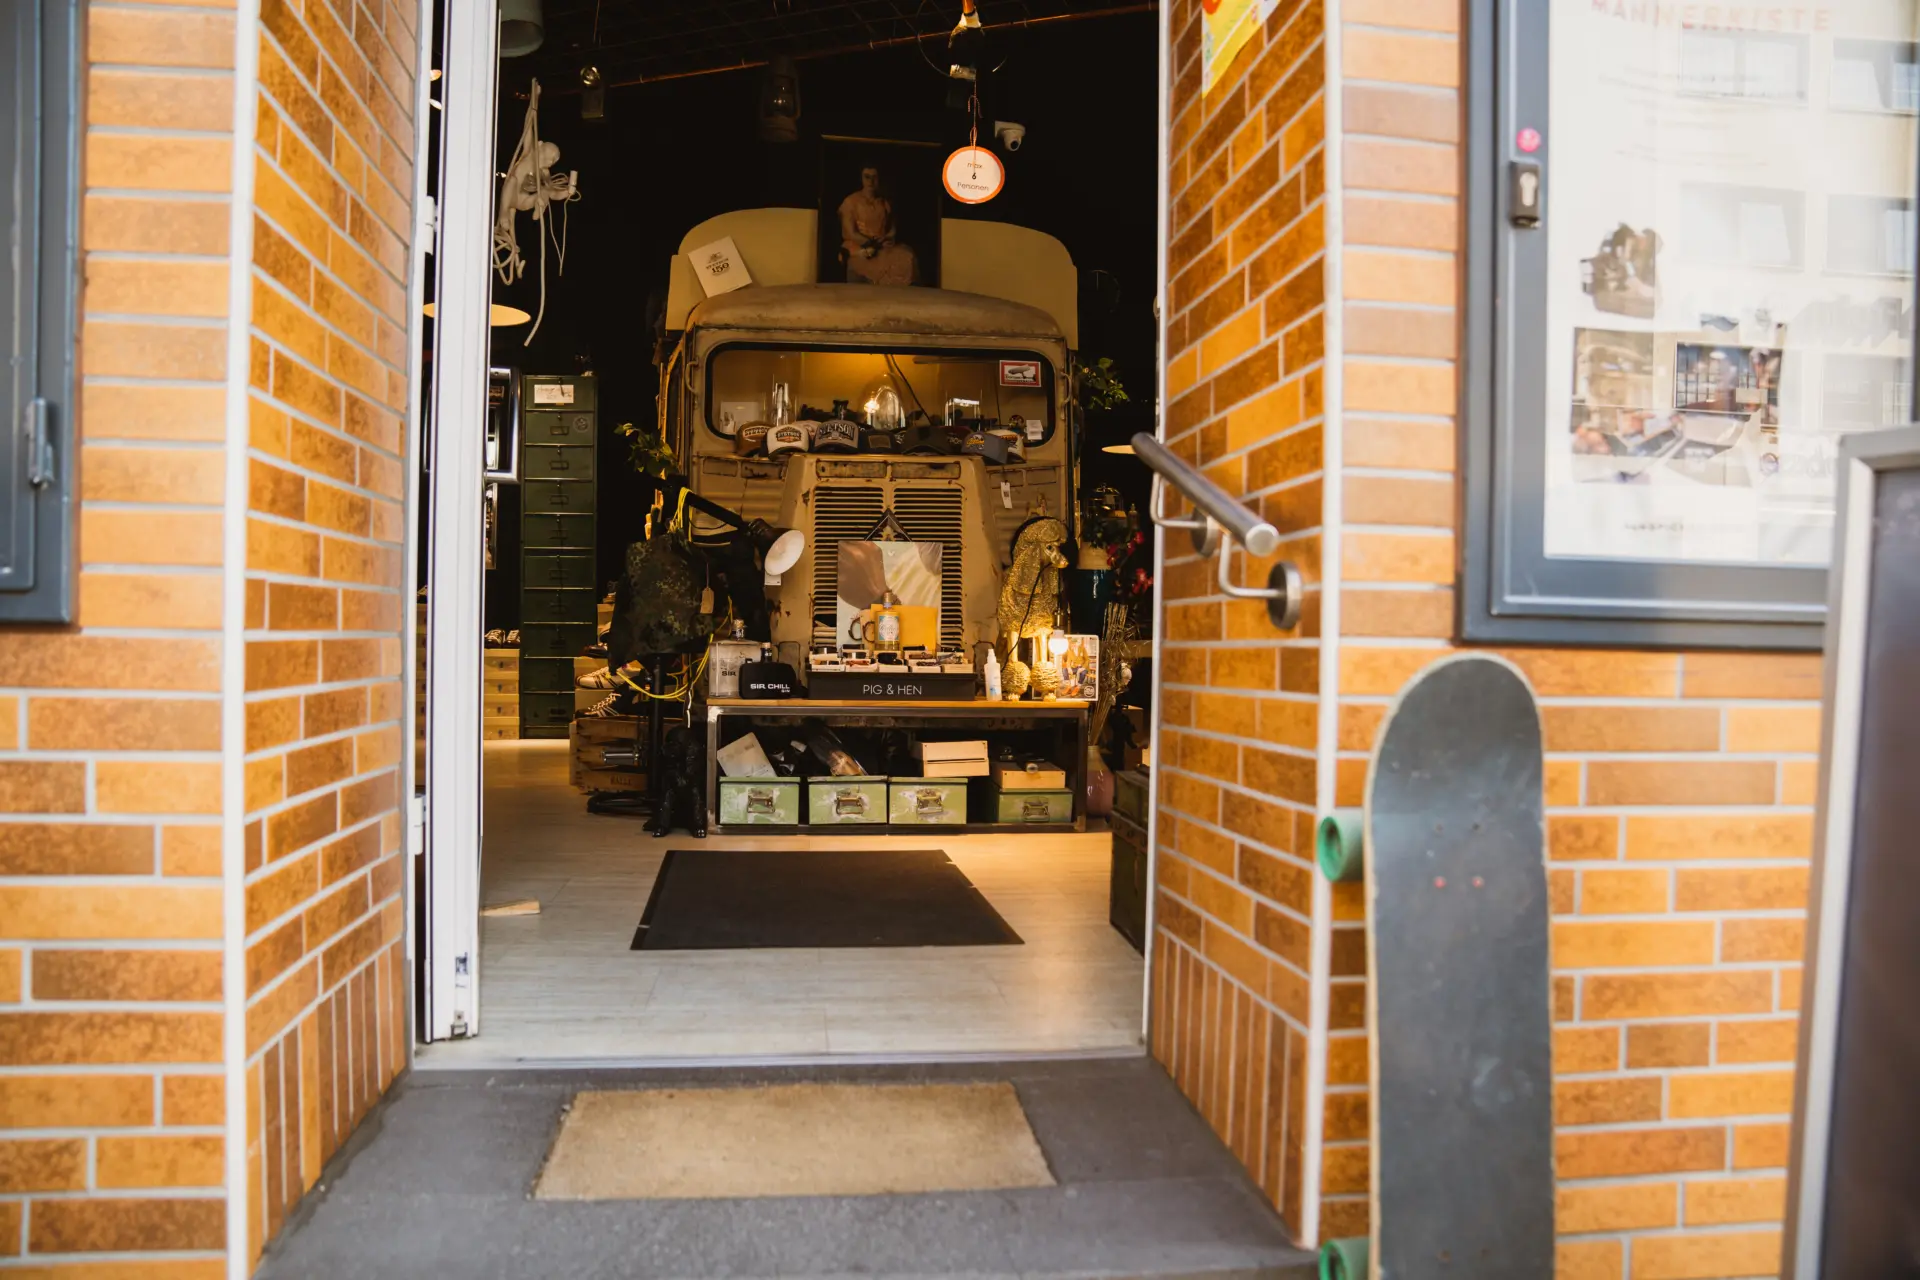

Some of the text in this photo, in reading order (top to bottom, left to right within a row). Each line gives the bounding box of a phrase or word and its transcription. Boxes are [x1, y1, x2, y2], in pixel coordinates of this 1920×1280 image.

[971, 172, 977, 180] 6
[957, 181, 989, 191] Personen
[711, 262, 730, 273] 150
[862, 683, 923, 695] PIG & HEN
